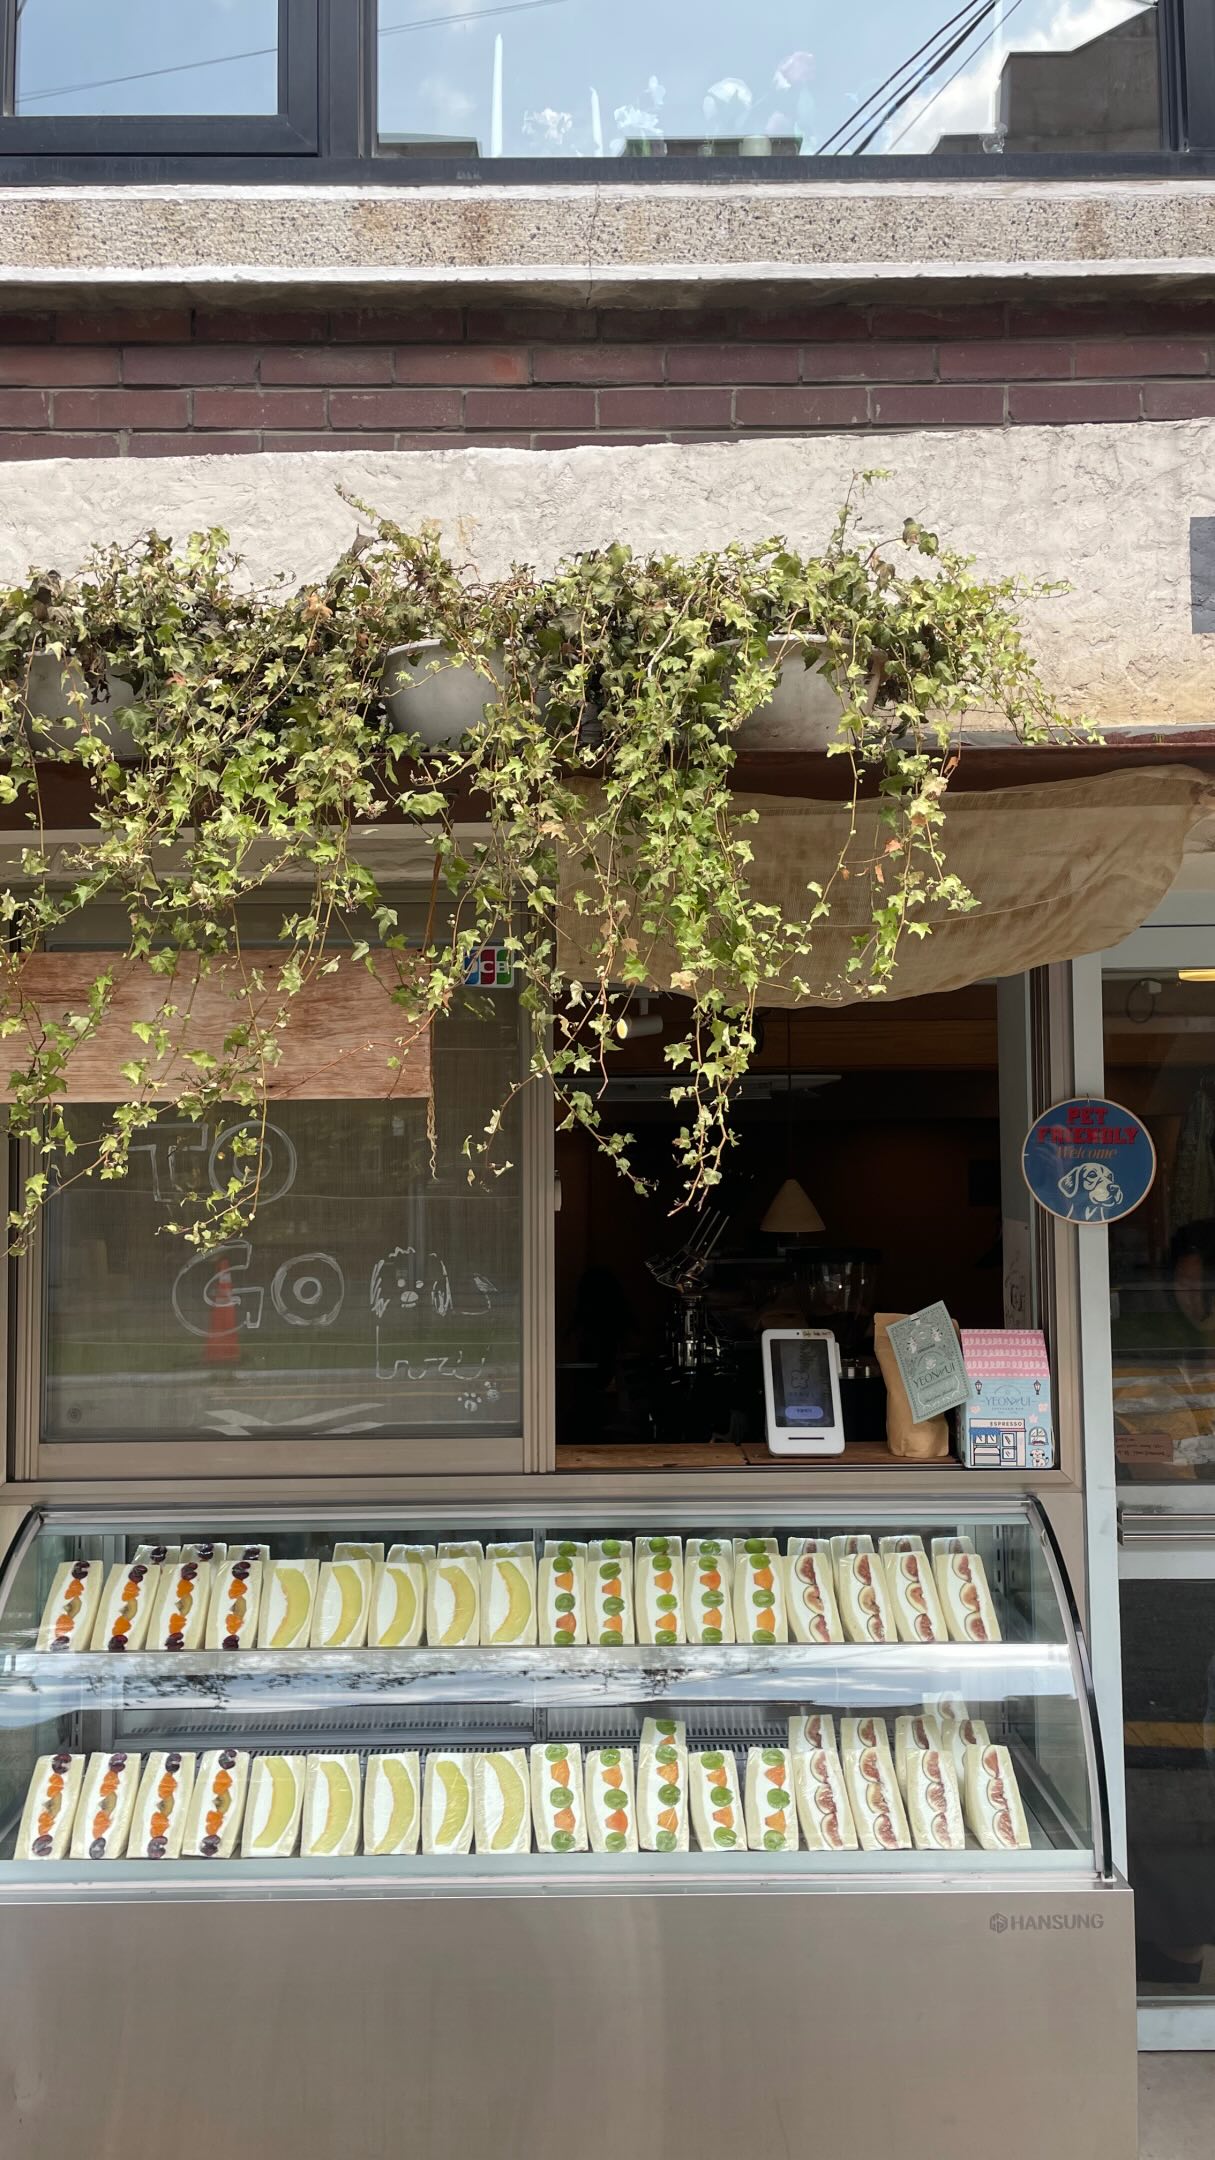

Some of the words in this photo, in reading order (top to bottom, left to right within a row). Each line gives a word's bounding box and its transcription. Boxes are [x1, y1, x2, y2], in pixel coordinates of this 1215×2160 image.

[1067, 1106, 1108, 1124] PET
[1056, 1145, 1118, 1159] Welcome
[114, 1120, 297, 1206] TO
[1010, 1913, 1104, 1931] HANSUNG
